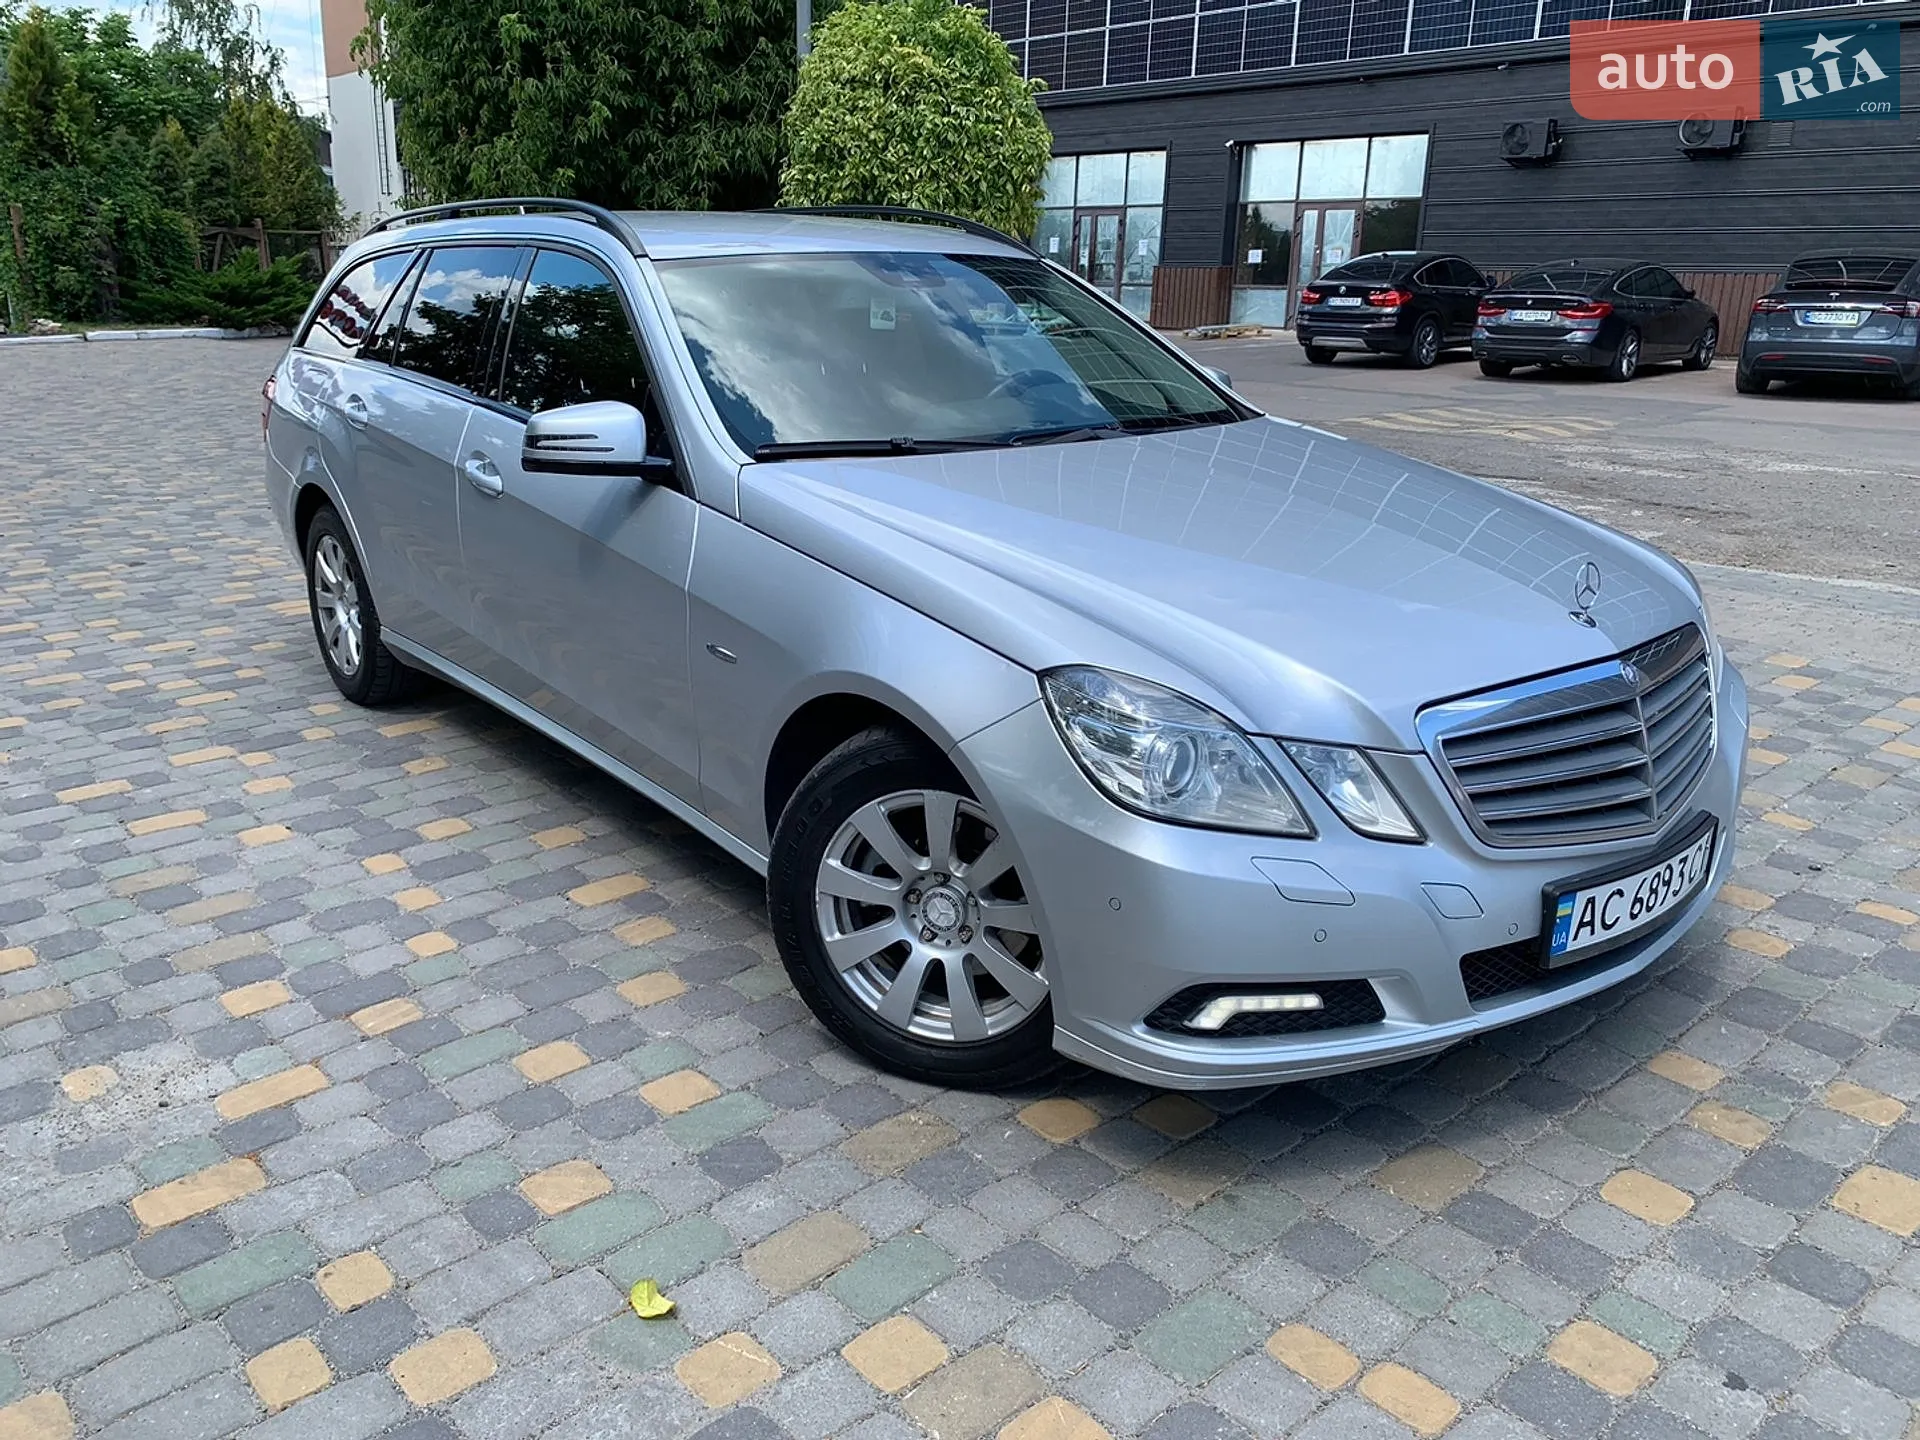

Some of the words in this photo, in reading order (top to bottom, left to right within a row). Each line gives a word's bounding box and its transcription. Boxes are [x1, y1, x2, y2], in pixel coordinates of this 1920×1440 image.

[1572, 888, 1625, 942] AC
[1629, 856, 1689, 921] 6893
[1552, 931, 1568, 947] UA
